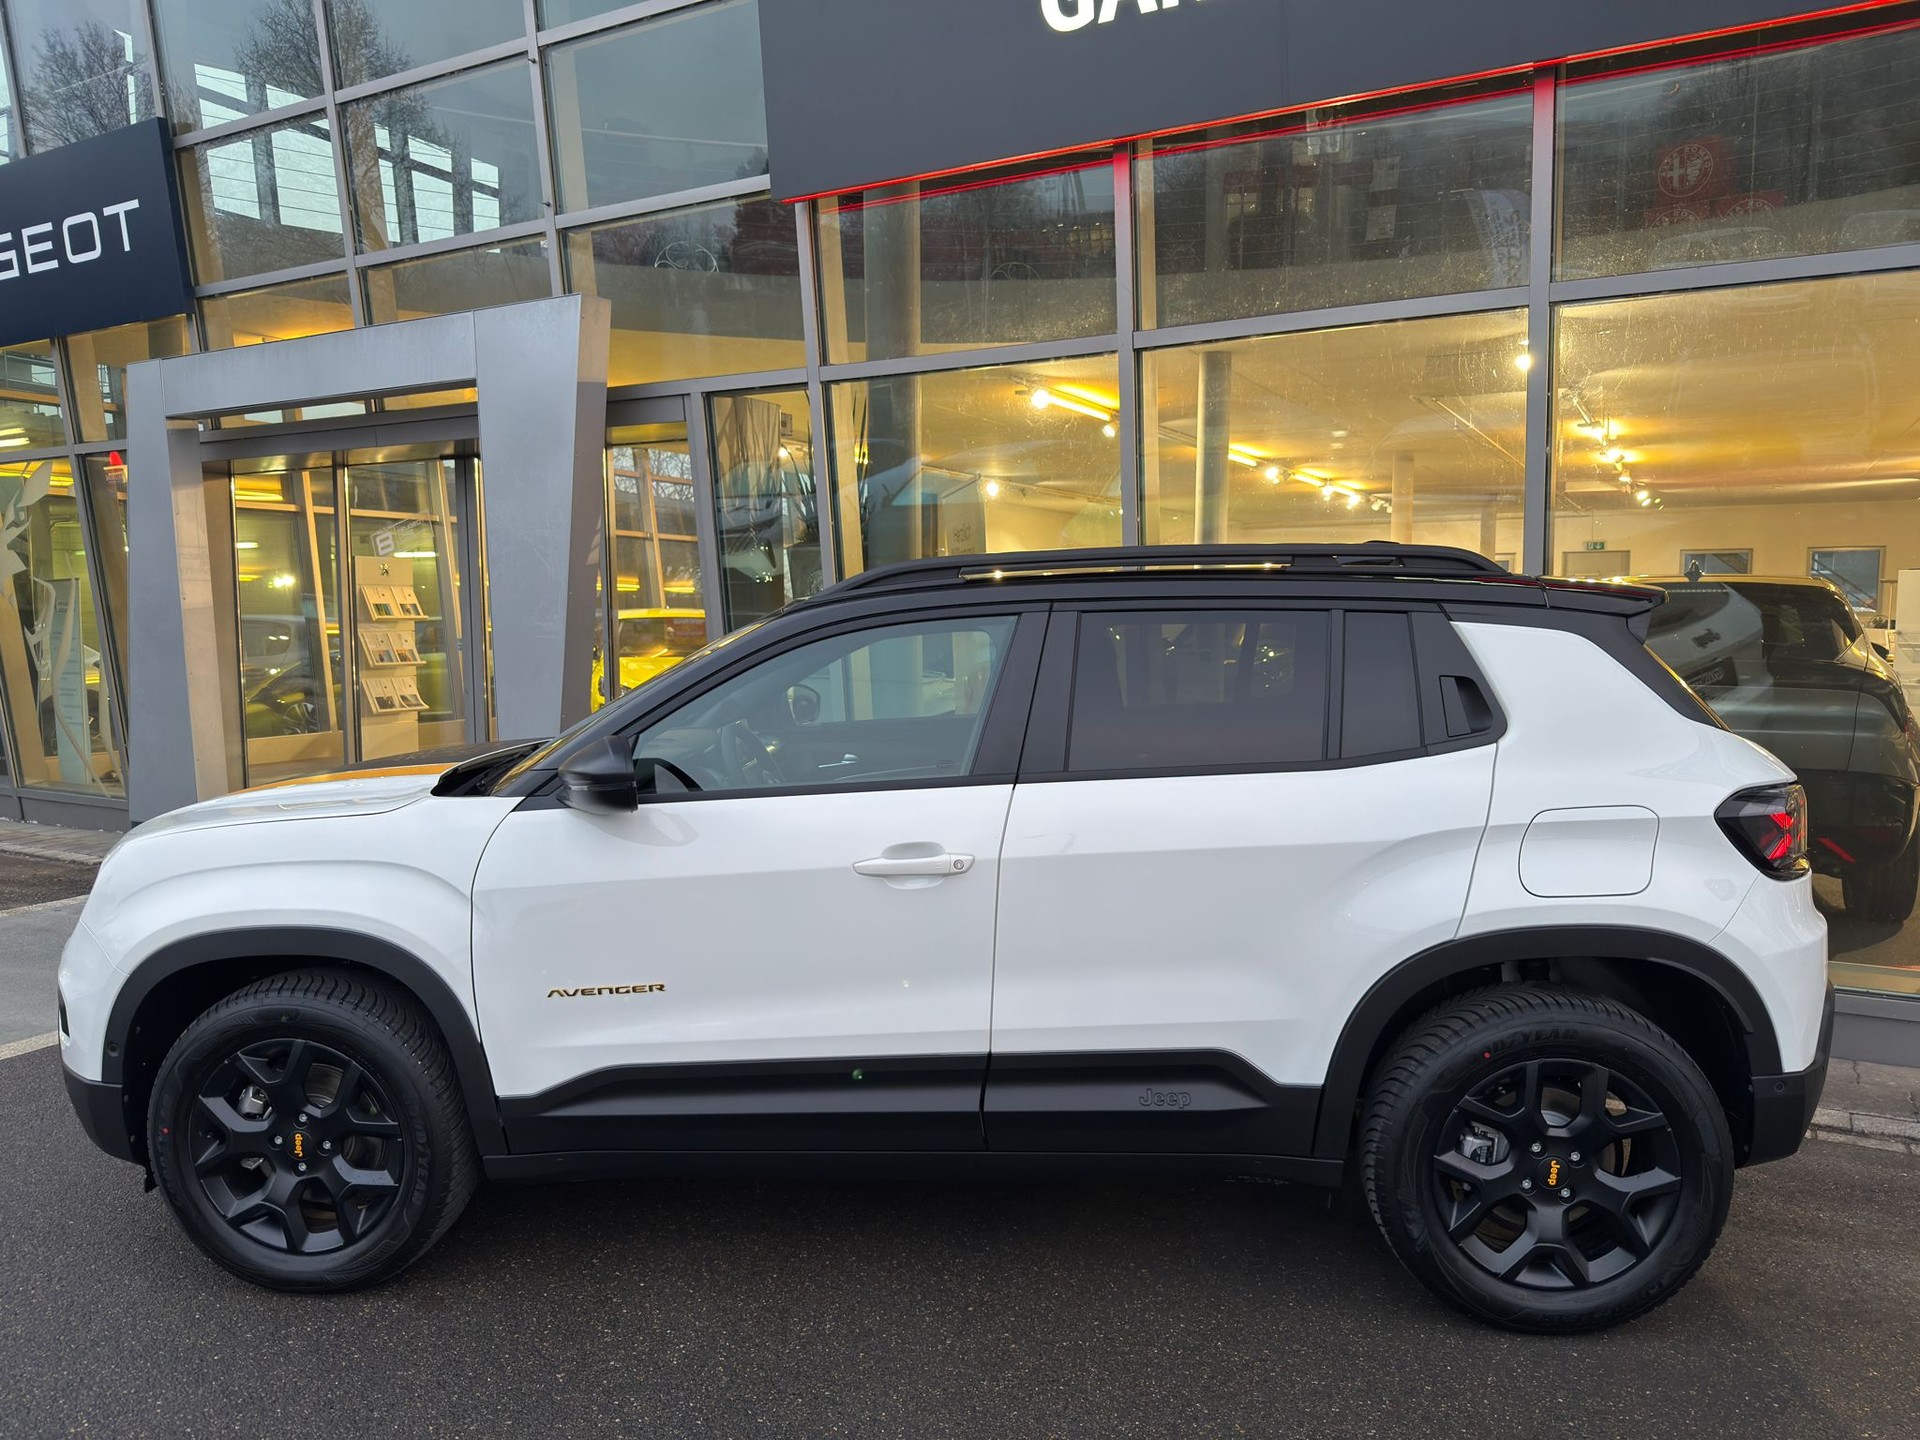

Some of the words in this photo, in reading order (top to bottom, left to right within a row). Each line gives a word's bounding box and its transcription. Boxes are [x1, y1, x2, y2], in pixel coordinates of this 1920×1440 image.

[547, 983, 666, 998] AVENGER
[1139, 1088, 1191, 1109] Jeep
[294, 1133, 303, 1157] Jeep
[1547, 1160, 1560, 1186] Jeep
